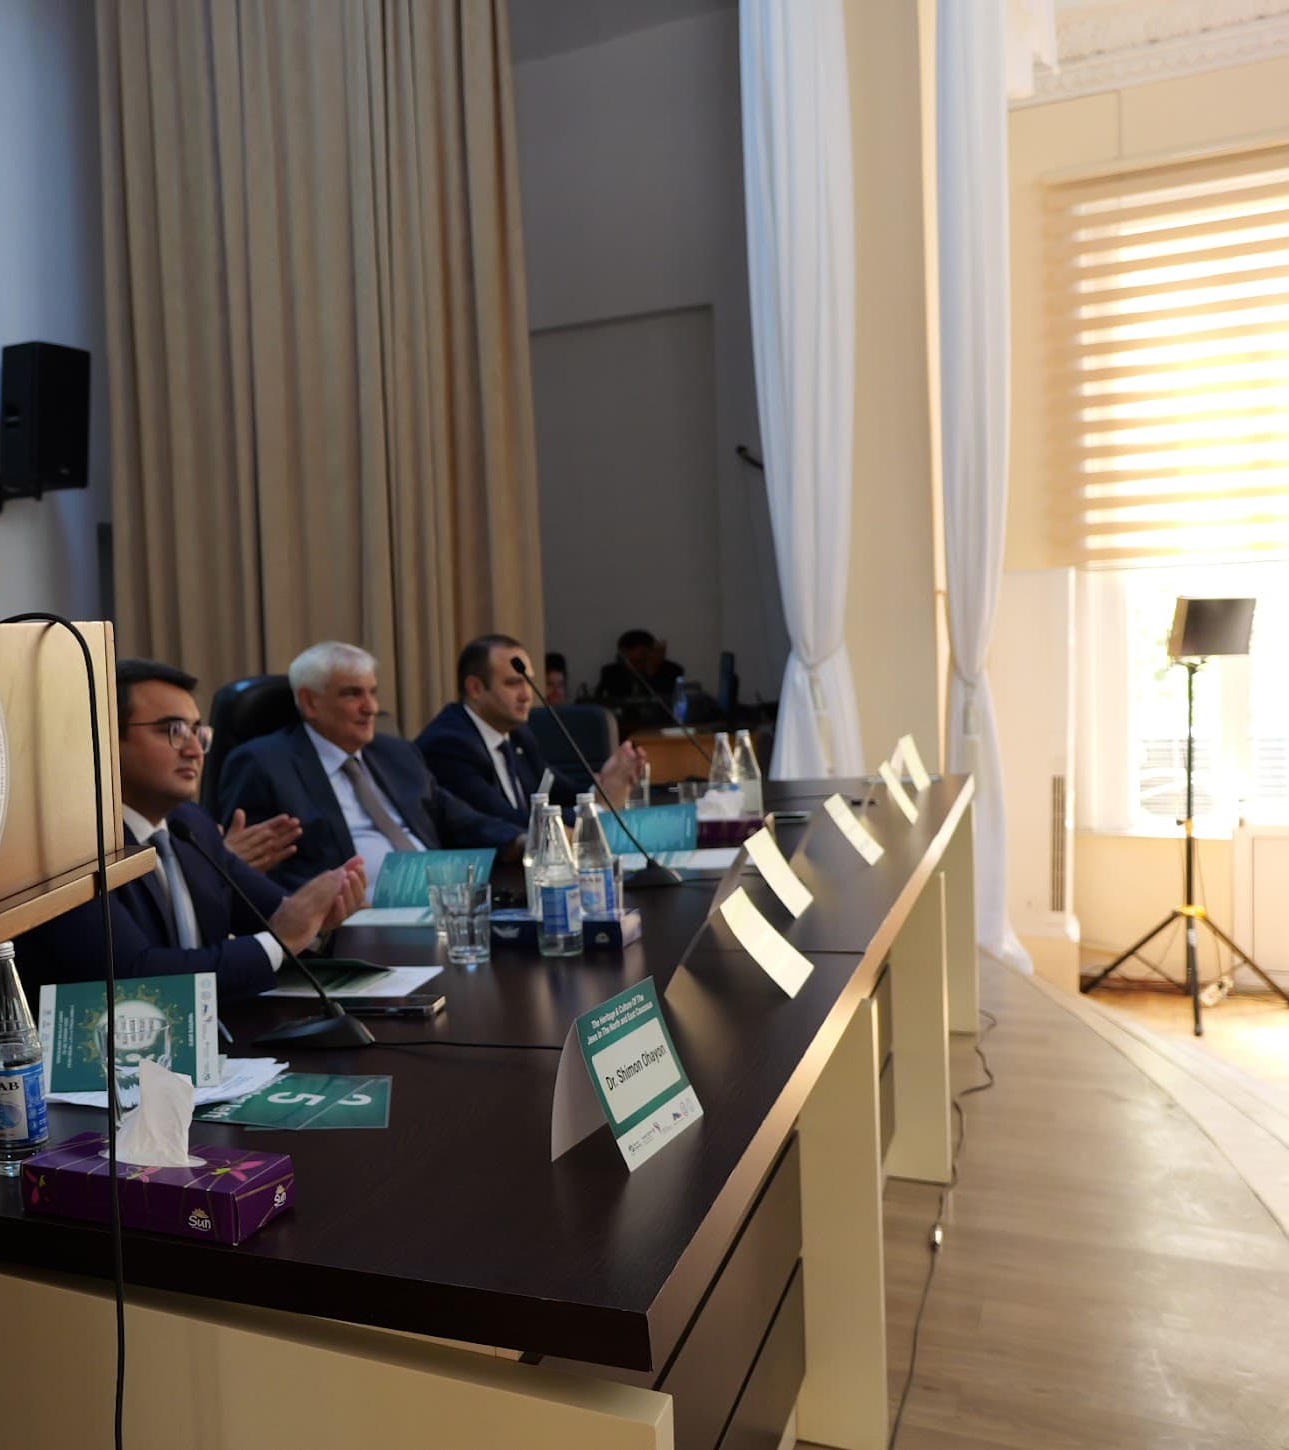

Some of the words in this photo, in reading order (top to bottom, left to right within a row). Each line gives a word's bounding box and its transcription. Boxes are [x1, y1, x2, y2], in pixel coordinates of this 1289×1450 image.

[605, 1076, 619, 1091] Dr.
[616, 1060, 644, 1084] Shimon
[641, 1044, 666, 1067] Ohayon
[267, 1091, 327, 1106] 5
[188, 1214, 211, 1230] Sun
